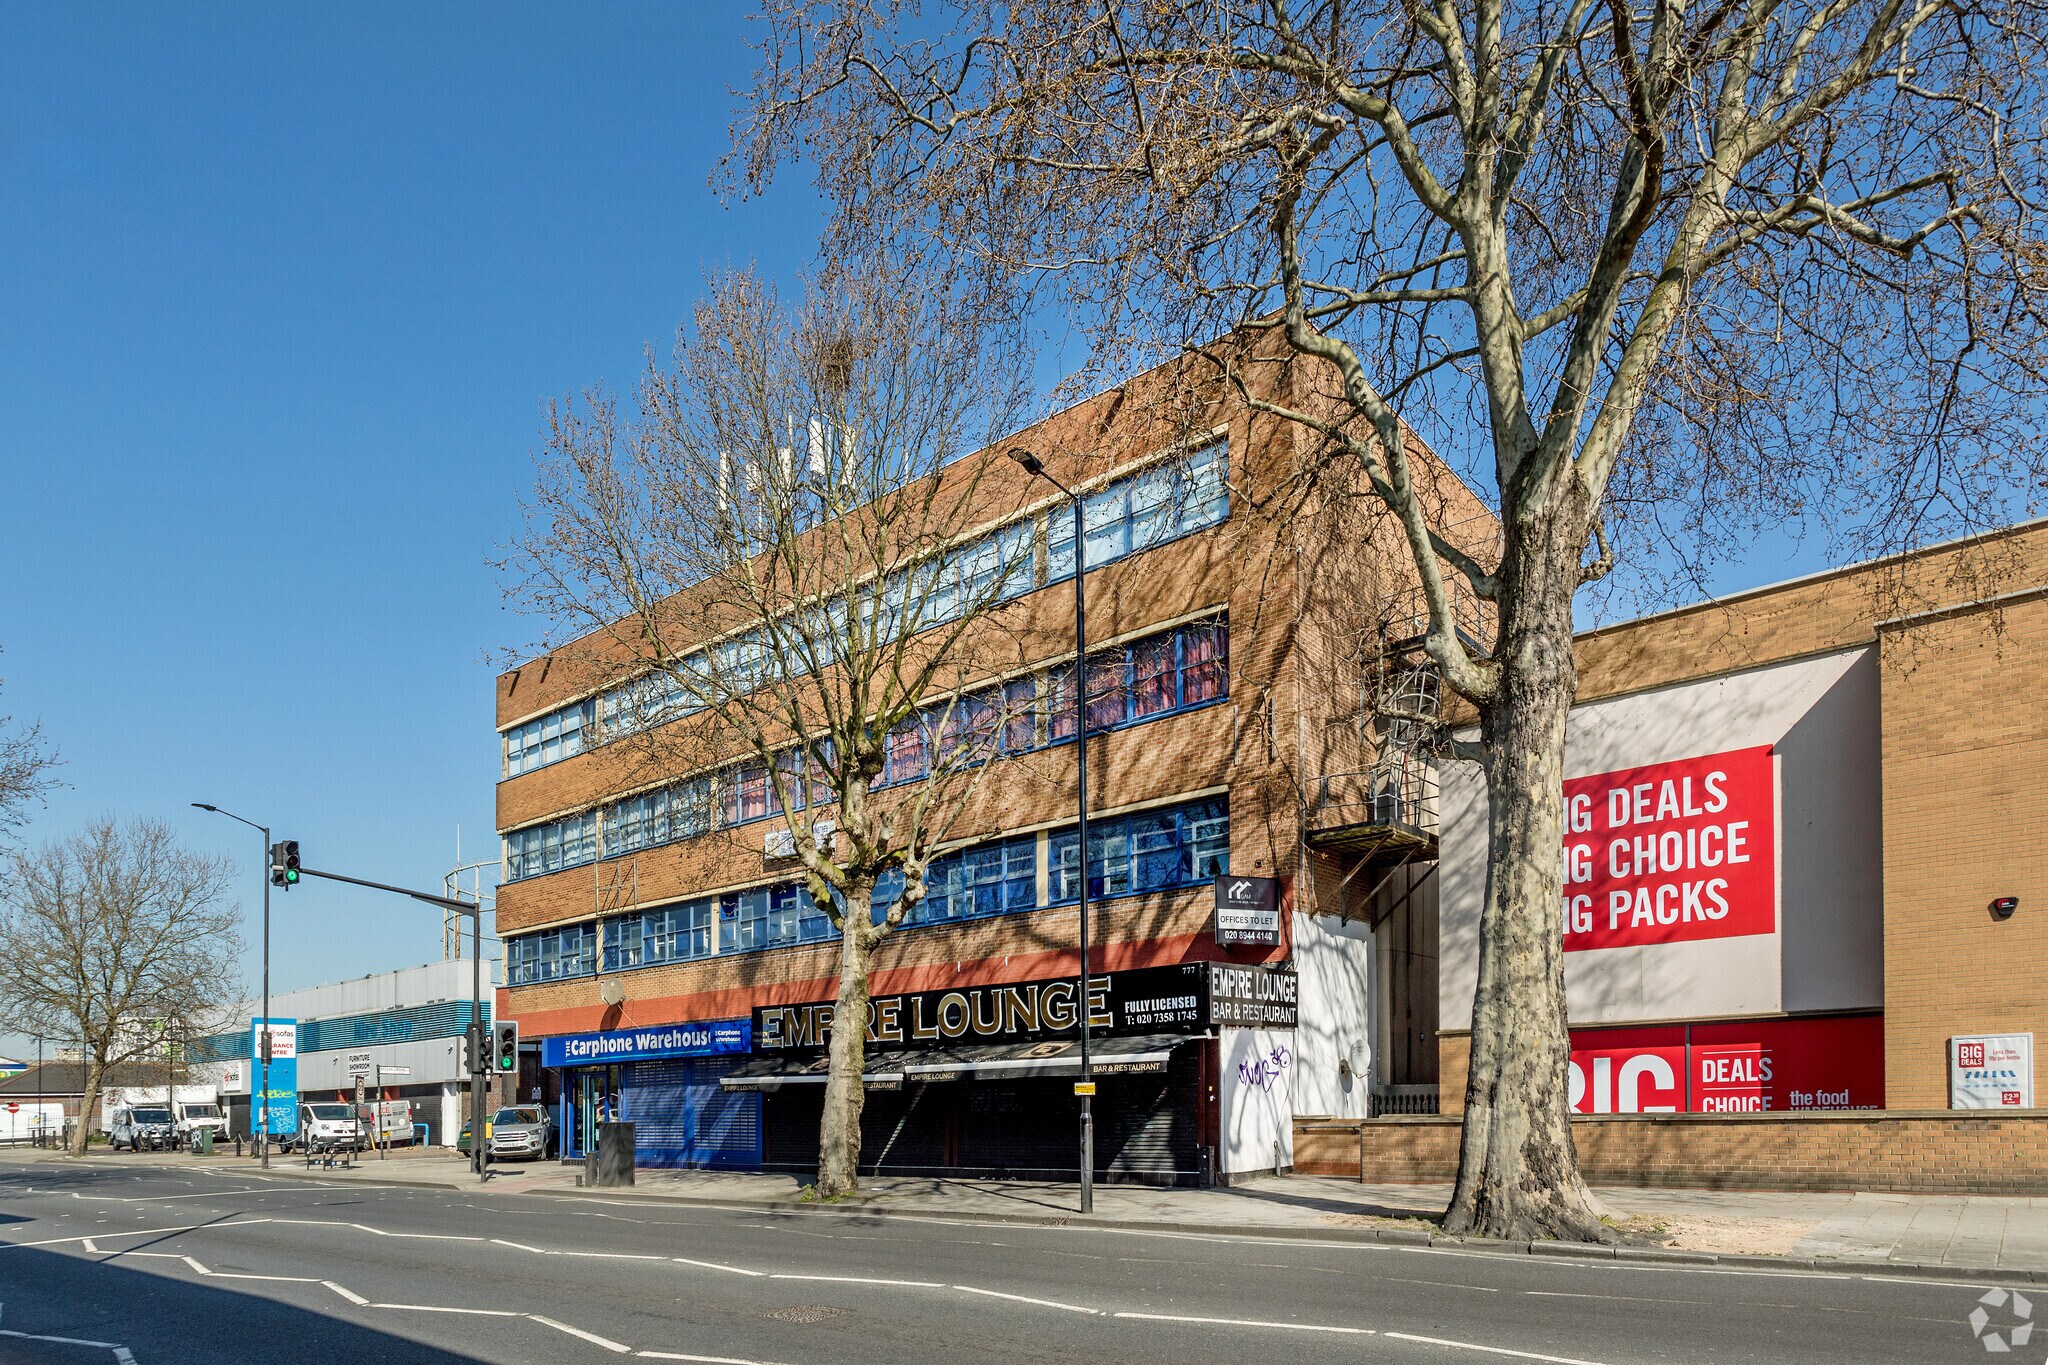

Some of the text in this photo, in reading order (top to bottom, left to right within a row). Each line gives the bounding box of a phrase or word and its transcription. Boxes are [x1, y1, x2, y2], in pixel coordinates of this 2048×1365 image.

[1562, 771, 1728, 835] IG DEALS
[1562, 820, 1750, 884] IG CHOICE
[1562, 878, 1729, 935] IG PACKS
[1220, 915, 1273, 925] OFFICES TO LET
[1224, 930, 1273, 940] 020 8944 4140
[1182, 966, 1195, 974] 777
[1211, 966, 1296, 1003] EMPIRE LOUNGE
[911, 975, 1114, 1040] LOUNGE
[1125, 995, 1197, 1013] FULLY LICENSED
[1213, 1001, 1296, 1024] BAR & RESTAURANT
[1125, 1010, 1197, 1025] T: 020 7358 1745
[571, 1035, 633, 1057] Carphone
[635, 1029, 711, 1051] Warehous
[1961, 1046, 1982, 1059] BIG
[349, 1054, 370, 1062] FURNITURE
[1114, 1063, 1161, 1072] RESTAURANT
[1702, 1057, 1773, 1083] DEALS
[1569, 1054, 1676, 1113] IG
[1790, 1089, 1849, 1106] the food
